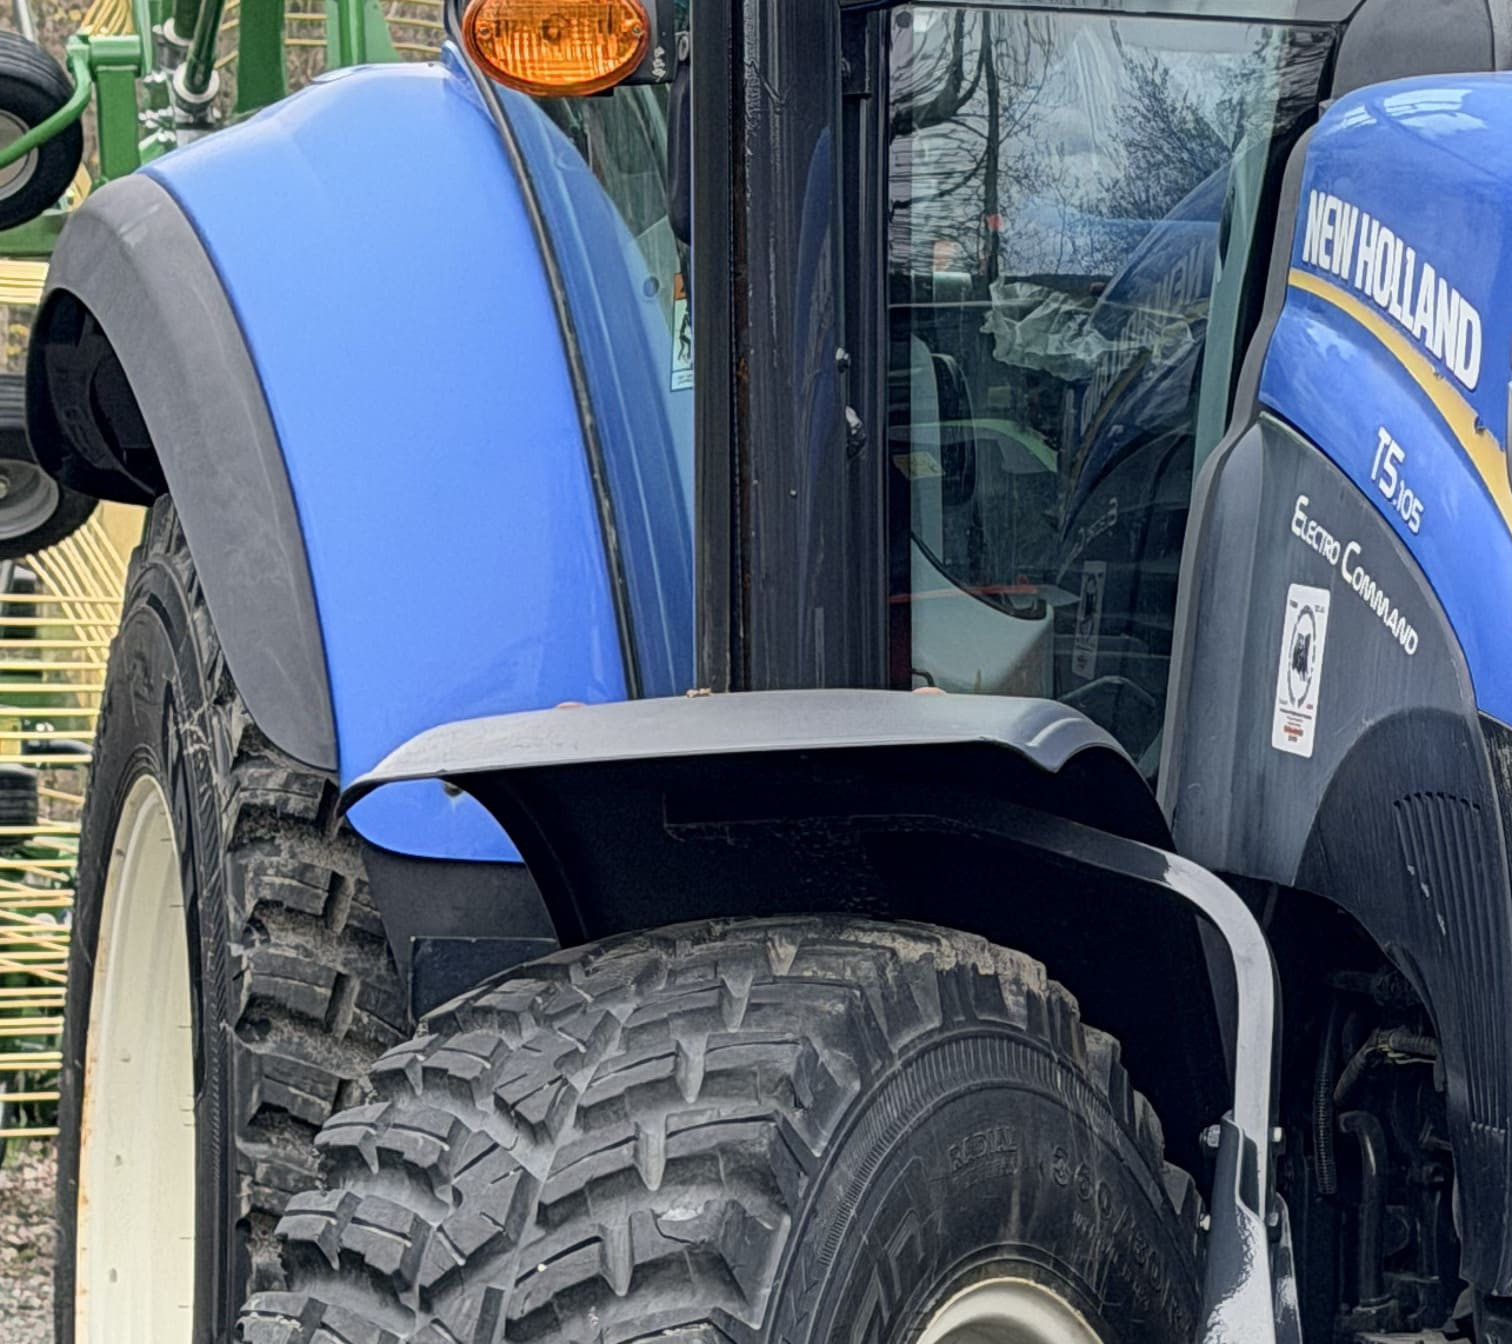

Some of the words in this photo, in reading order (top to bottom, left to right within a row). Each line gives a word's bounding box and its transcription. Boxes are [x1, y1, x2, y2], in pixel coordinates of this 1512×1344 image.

[1302, 189, 1359, 280] NEW
[1354, 212, 1482, 390] HOLLAND
[1371, 426, 1424, 534] T5.105
